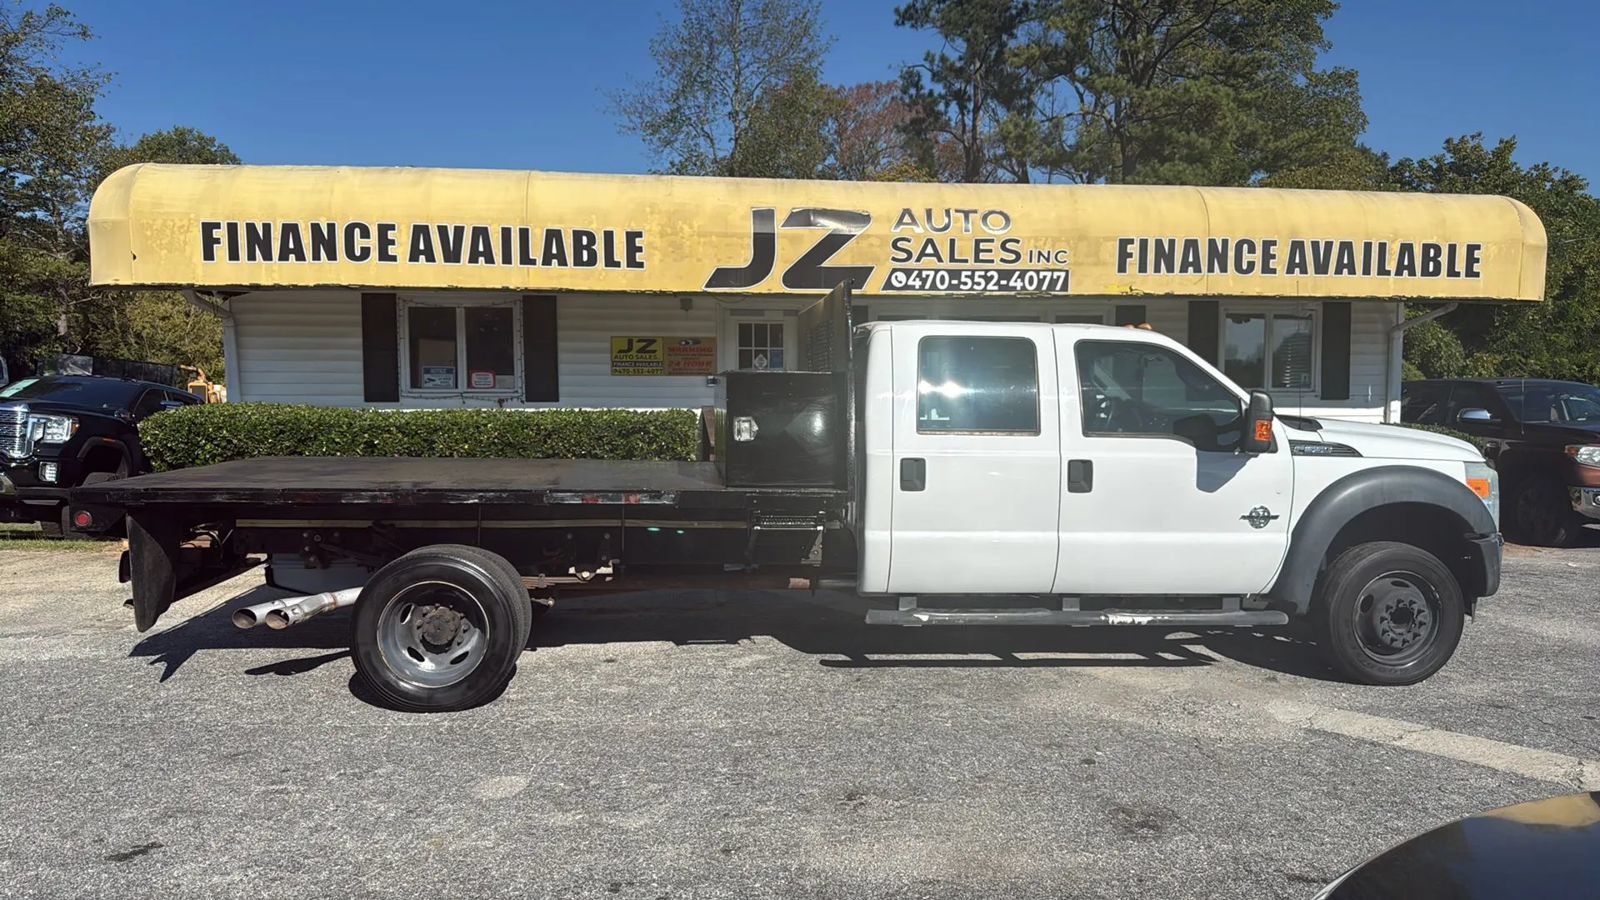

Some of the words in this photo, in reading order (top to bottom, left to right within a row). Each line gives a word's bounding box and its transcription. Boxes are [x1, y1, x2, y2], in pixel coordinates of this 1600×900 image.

[892, 207, 1011, 234] AUTO
[200, 221, 399, 263] FINANCE
[407, 223, 645, 269] AVAILABLE
[703, 207, 875, 290] JZ
[890, 236, 1022, 265] SALES
[1028, 249, 1069, 265] INC
[1116, 237, 1278, 275] FINANCE
[1285, 239, 1482, 279] AVAILABLE
[906, 269, 1067, 292] 470-552-4077
[617, 338, 658, 354] JZ
